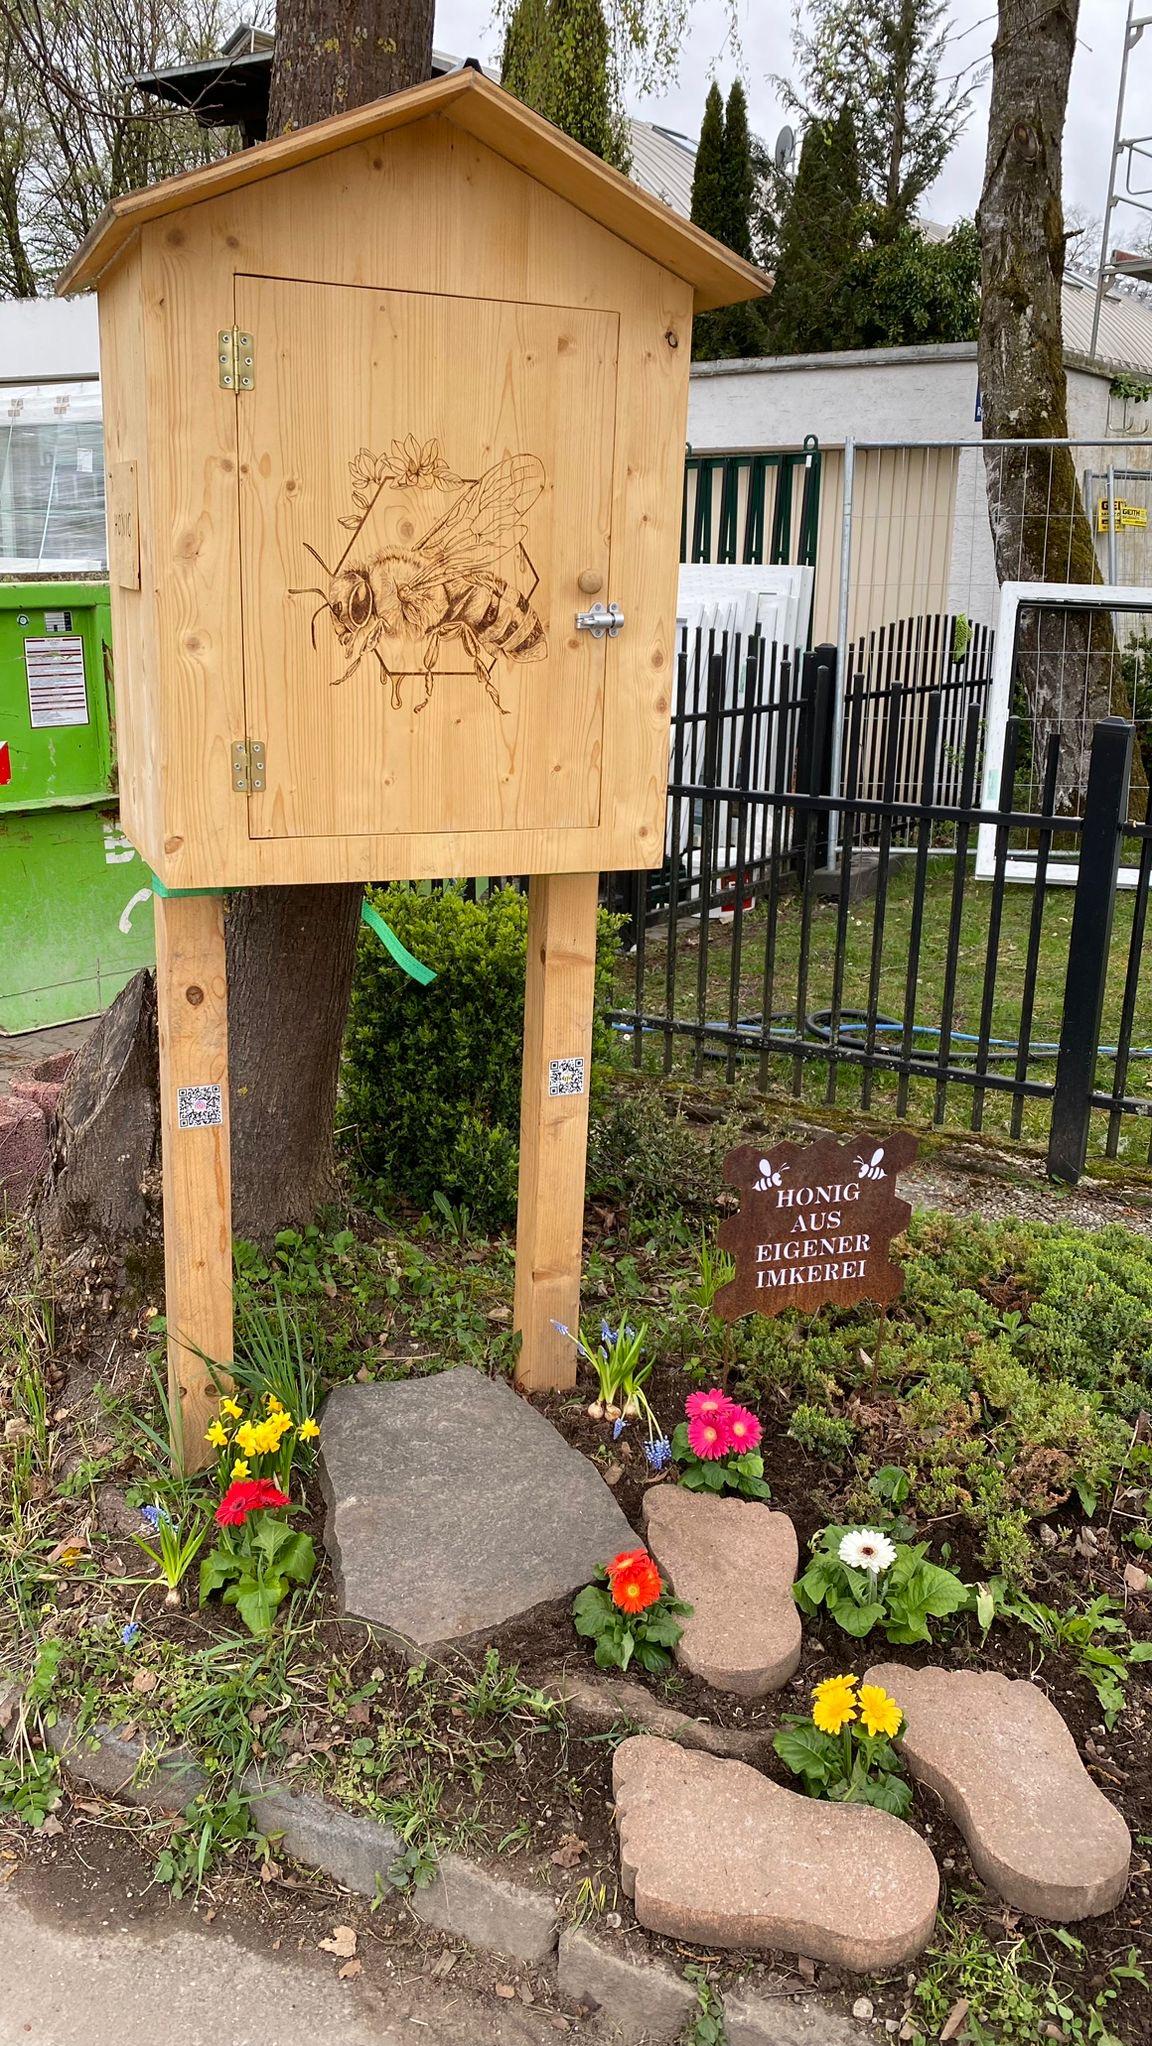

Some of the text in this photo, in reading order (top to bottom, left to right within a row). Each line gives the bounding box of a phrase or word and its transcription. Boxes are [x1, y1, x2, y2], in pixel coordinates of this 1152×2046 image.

[776, 1183, 860, 1208] HONIG
[790, 1210, 841, 1233] AUS
[755, 1233, 871, 1262] EIGENER
[755, 1259, 867, 1288] IMKEREI
